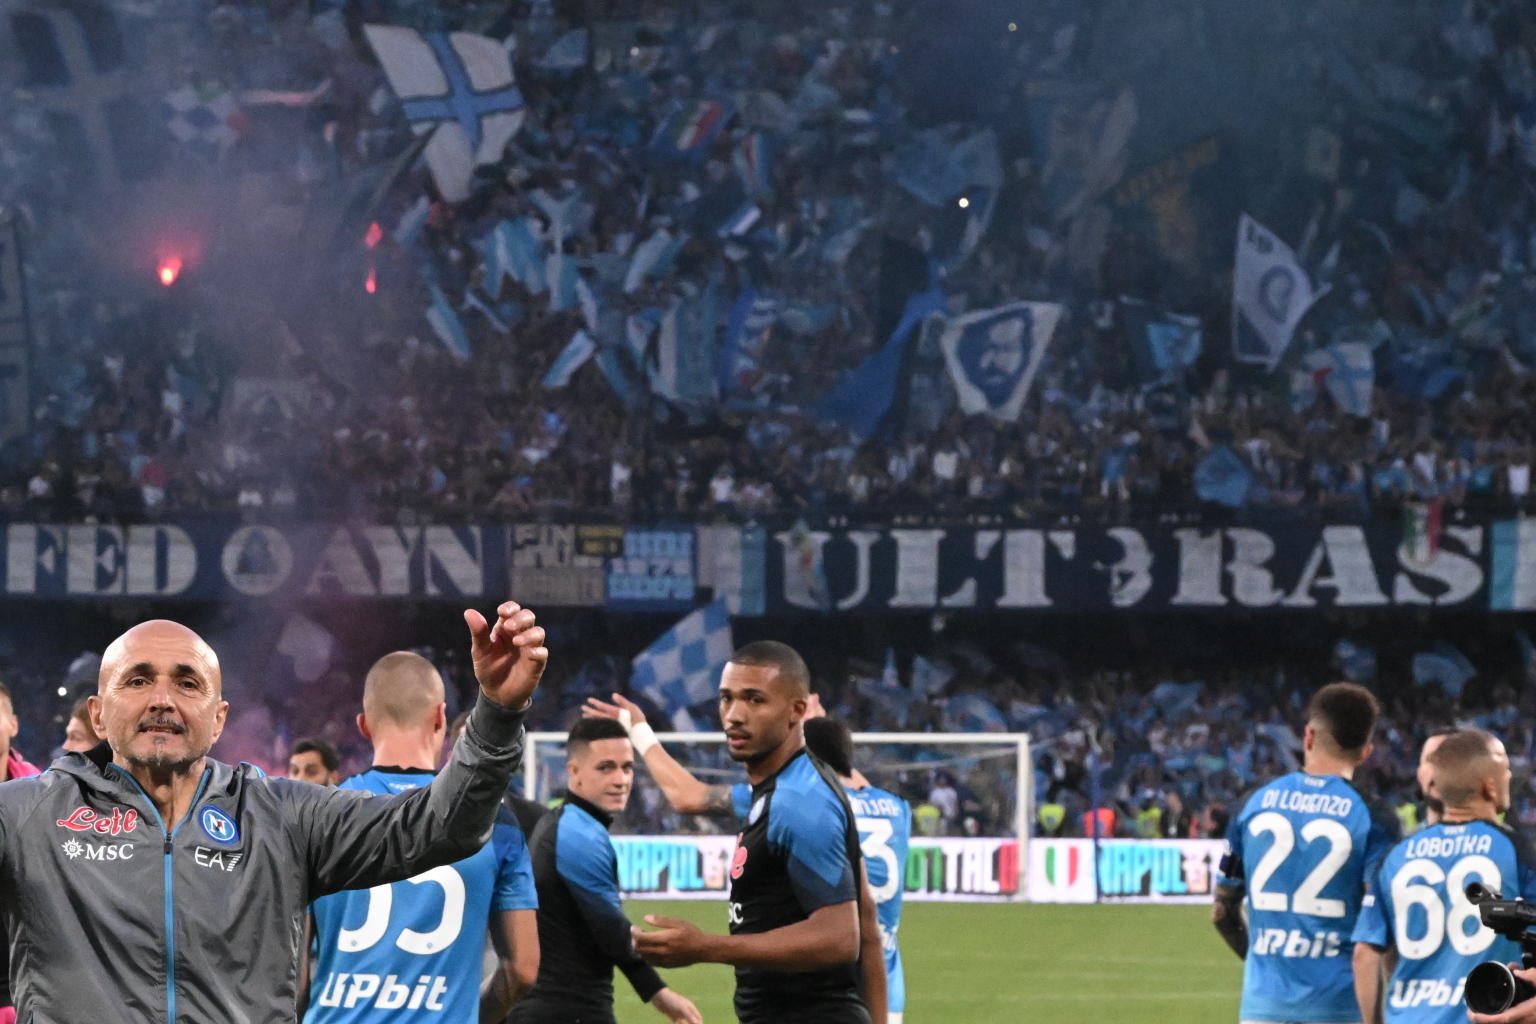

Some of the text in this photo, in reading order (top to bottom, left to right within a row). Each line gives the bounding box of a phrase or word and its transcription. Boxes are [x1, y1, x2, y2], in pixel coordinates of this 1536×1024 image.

[1261, 789, 1353, 817] DI LORENZO
[84, 843, 135, 861] MSC
[194, 835, 244, 872] EA7
[855, 817, 899, 904] 3
[1248, 811, 1352, 918] 22
[1405, 834, 1492, 858] LOBOTKA
[1391, 855, 1501, 960] 68
[1389, 978, 1467, 1018] UPbi
